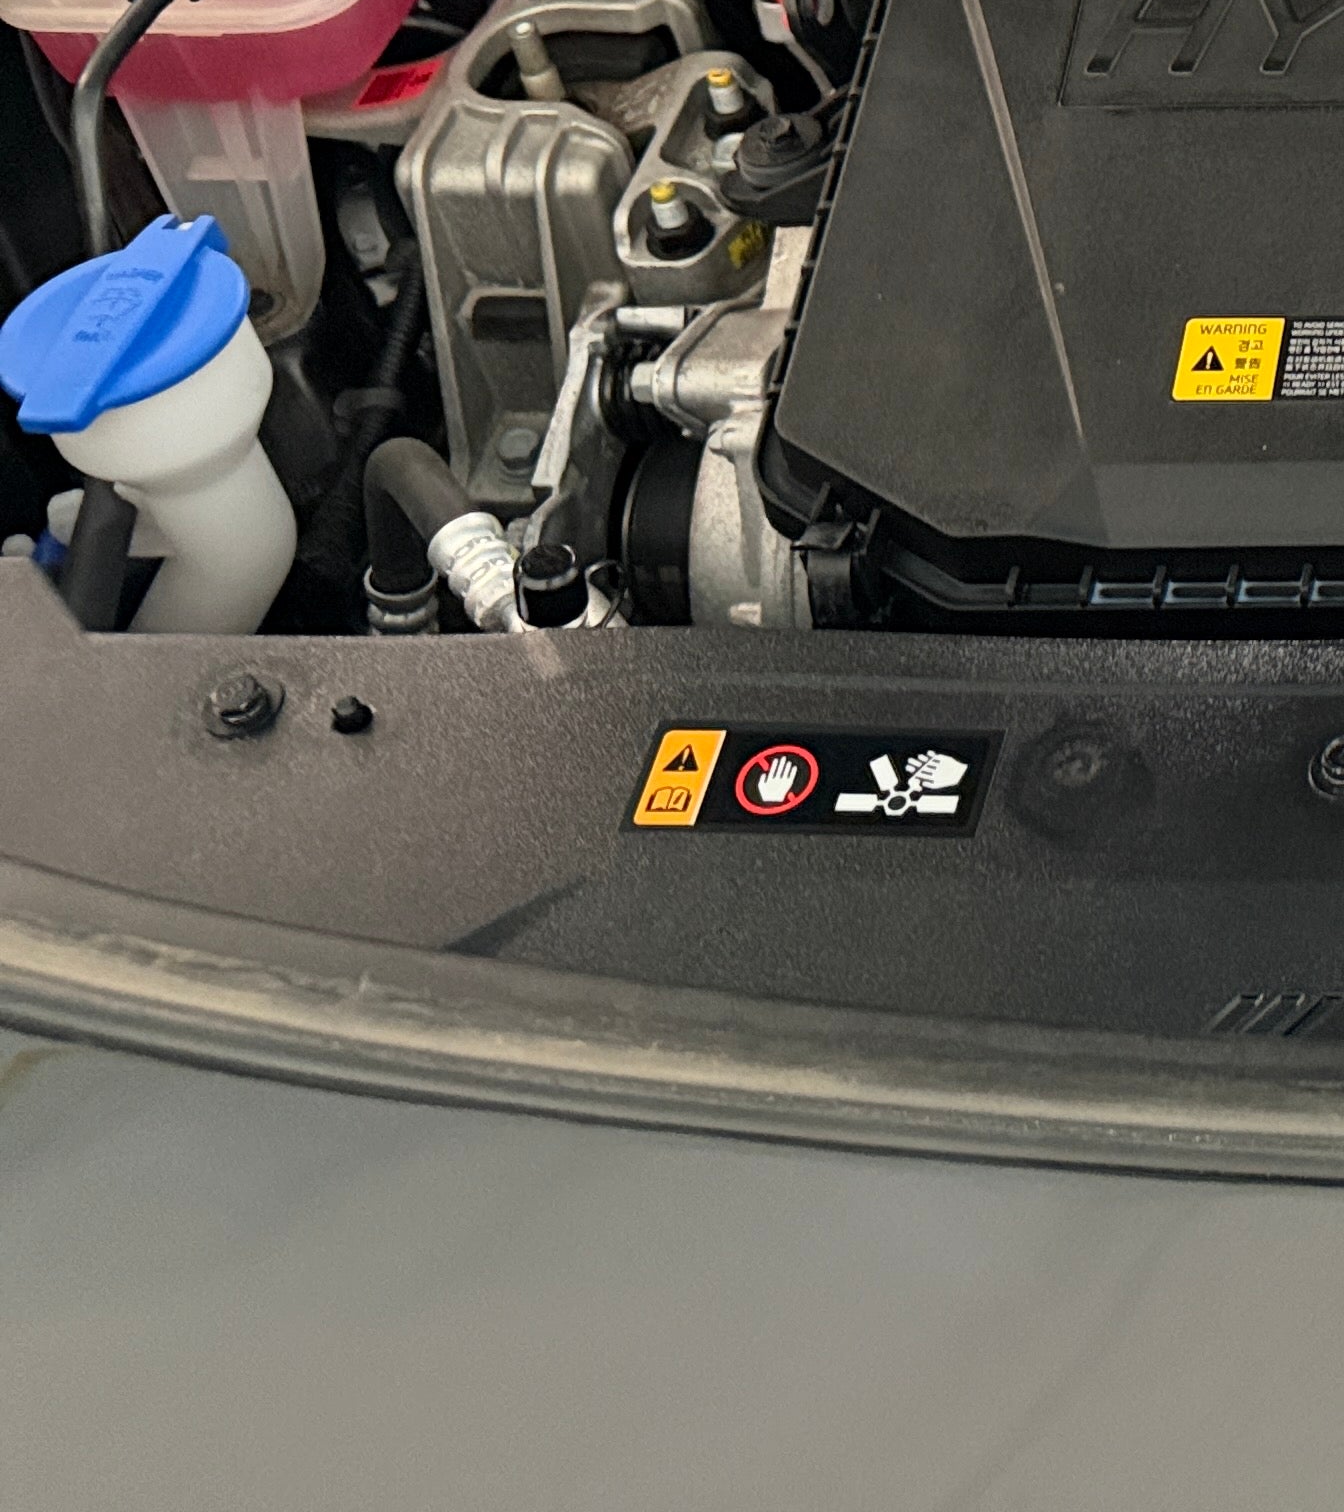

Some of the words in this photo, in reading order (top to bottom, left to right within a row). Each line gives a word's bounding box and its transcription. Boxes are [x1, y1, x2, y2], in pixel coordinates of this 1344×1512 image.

[1200, 324, 1267, 335] WARNING
[1229, 374, 1258, 383] MISE
[1196, 385, 1211, 394] EN
[1216, 384, 1257, 394] GARDE
